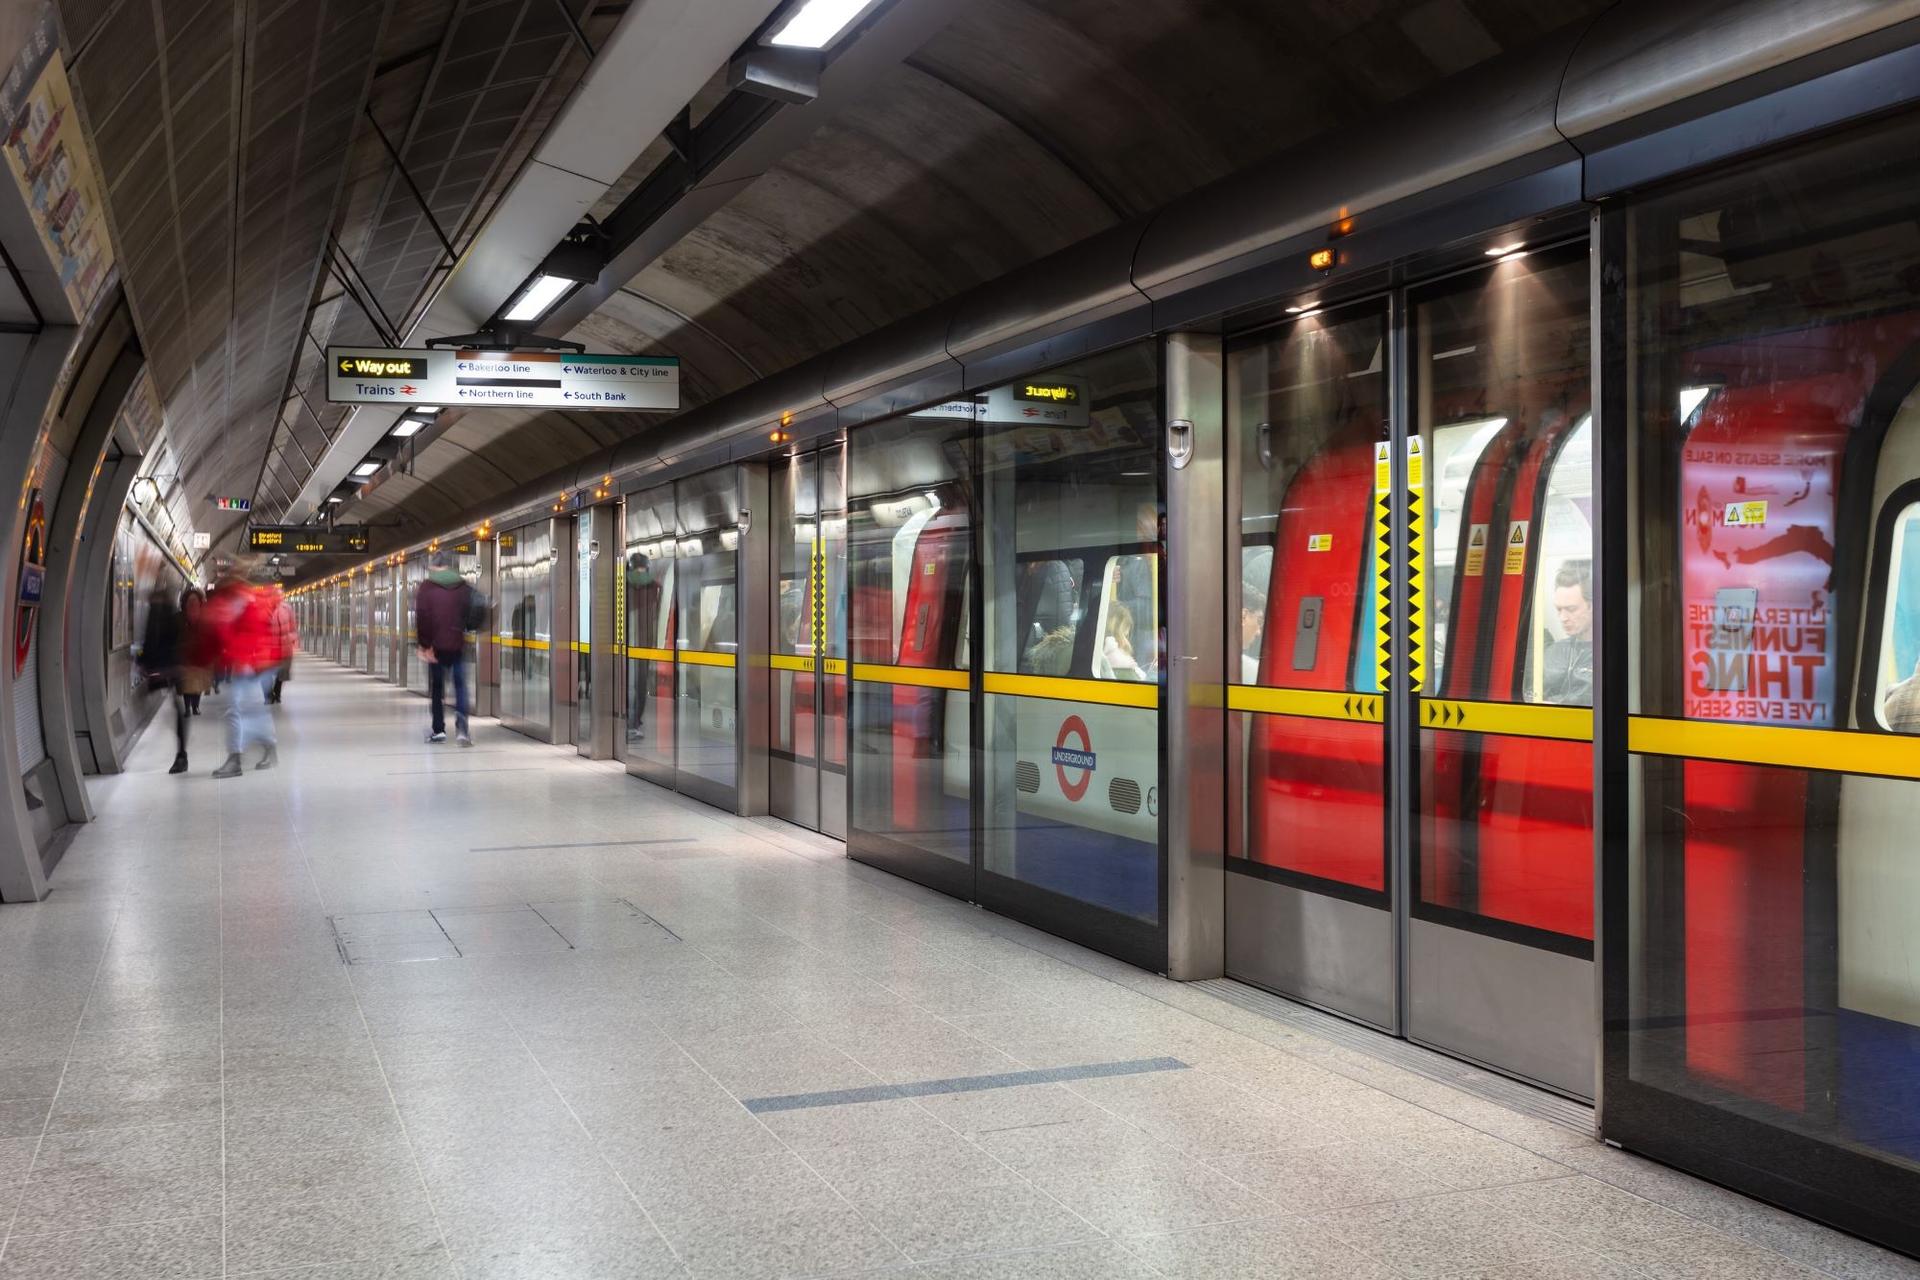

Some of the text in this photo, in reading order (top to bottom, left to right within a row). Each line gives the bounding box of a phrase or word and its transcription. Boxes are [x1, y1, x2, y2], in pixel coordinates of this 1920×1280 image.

[355, 360, 411, 375] Way out
[468, 362, 531, 373] Bakerloo line
[574, 365, 669, 378] Waterloo & City line
[356, 383, 395, 395] Trains
[469, 389, 534, 398] Northern line
[574, 391, 626, 401] South Bank
[1053, 751, 1094, 766] UNDERGROUND
